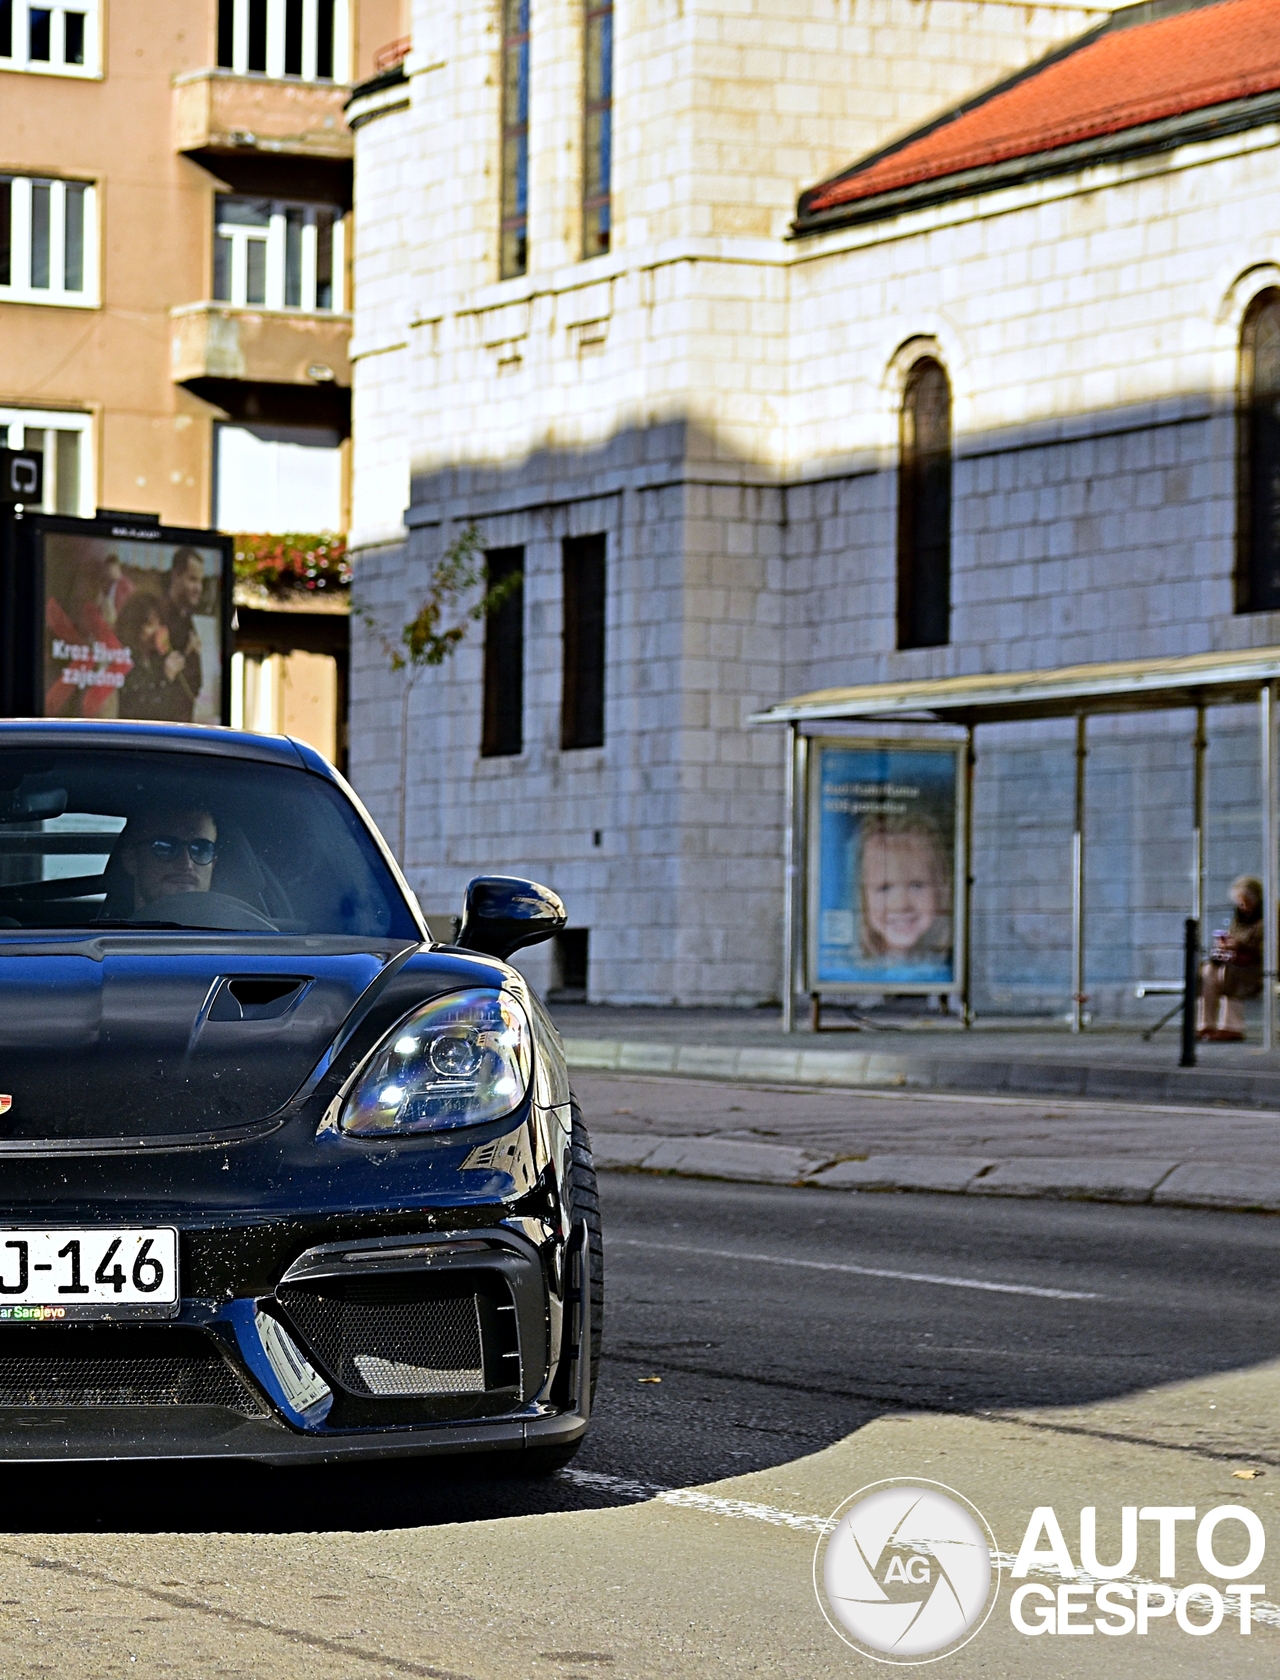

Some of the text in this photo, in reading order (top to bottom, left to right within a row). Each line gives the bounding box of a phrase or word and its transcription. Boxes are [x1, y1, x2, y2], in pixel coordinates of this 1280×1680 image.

[52, 639, 91, 661] Kroz
[62, 666, 125, 690] zajedno
[14, 1306, 66, 1321] Sarajevo
